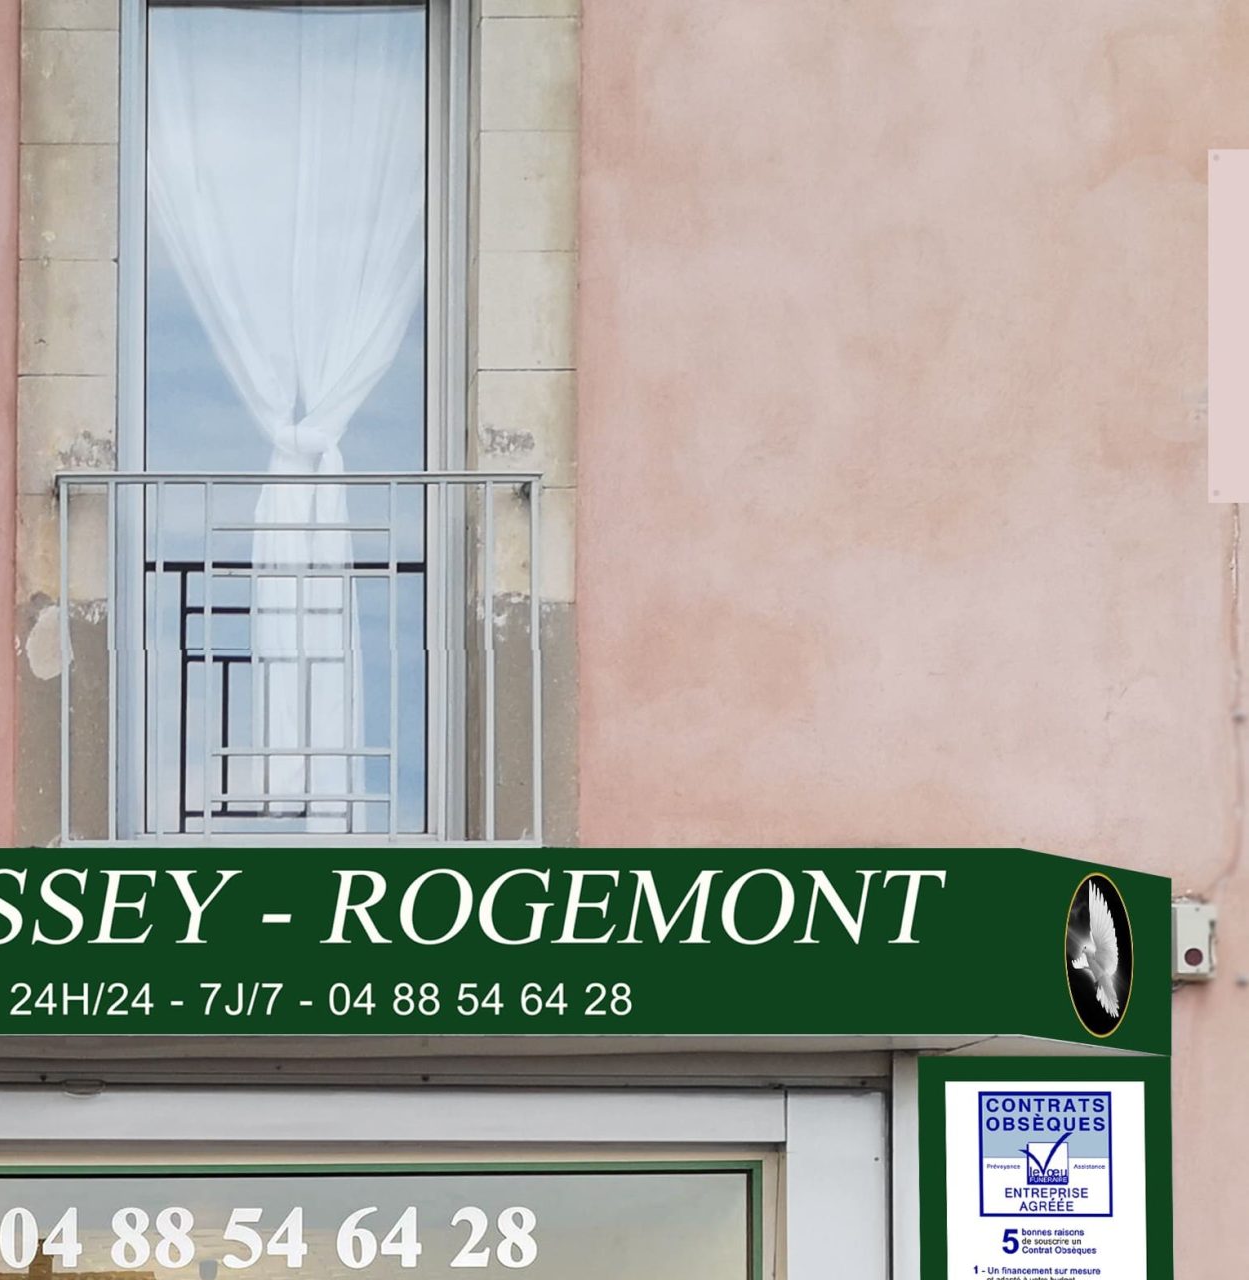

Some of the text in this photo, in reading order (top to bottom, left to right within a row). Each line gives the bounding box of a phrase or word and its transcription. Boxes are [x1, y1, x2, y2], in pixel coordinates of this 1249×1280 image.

[319, 868, 947, 946] ROGEMONT
[9, 982, 154, 1016] 24H/24
[199, 982, 284, 1016] 7J/7
[328, 982, 376, 1016] 04
[392, 982, 441, 1016] 88
[456, 982, 504, 1016] 54
[520, 982, 568, 1016] 64
[584, 982, 633, 1016] 28
[986, 1098, 1105, 1112] CONTRATS
[986, 1113, 1105, 1132] OBSÈQUES
[1004, 1187, 1089, 1200] ENTREPRISE
[1018, 1197, 1075, 1213] AGRÉÉE
[0, 1207, 83, 1269] 04
[110, 1206, 196, 1269] 88
[222, 1206, 308, 1269] 54
[336, 1206, 422, 1269] 64
[450, 1206, 538, 1268] 28
[1022, 1228, 1084, 1237] bonnes raisons
[1001, 1228, 1020, 1255] 5
[1022, 1238, 1031, 1246] de
[1022, 1246, 1096, 1256] Contrat Obsèques
[974, 1265, 978, 1275] 1
[988, 1267, 999, 1275] Un
[1002, 1267, 1052, 1275] financement
